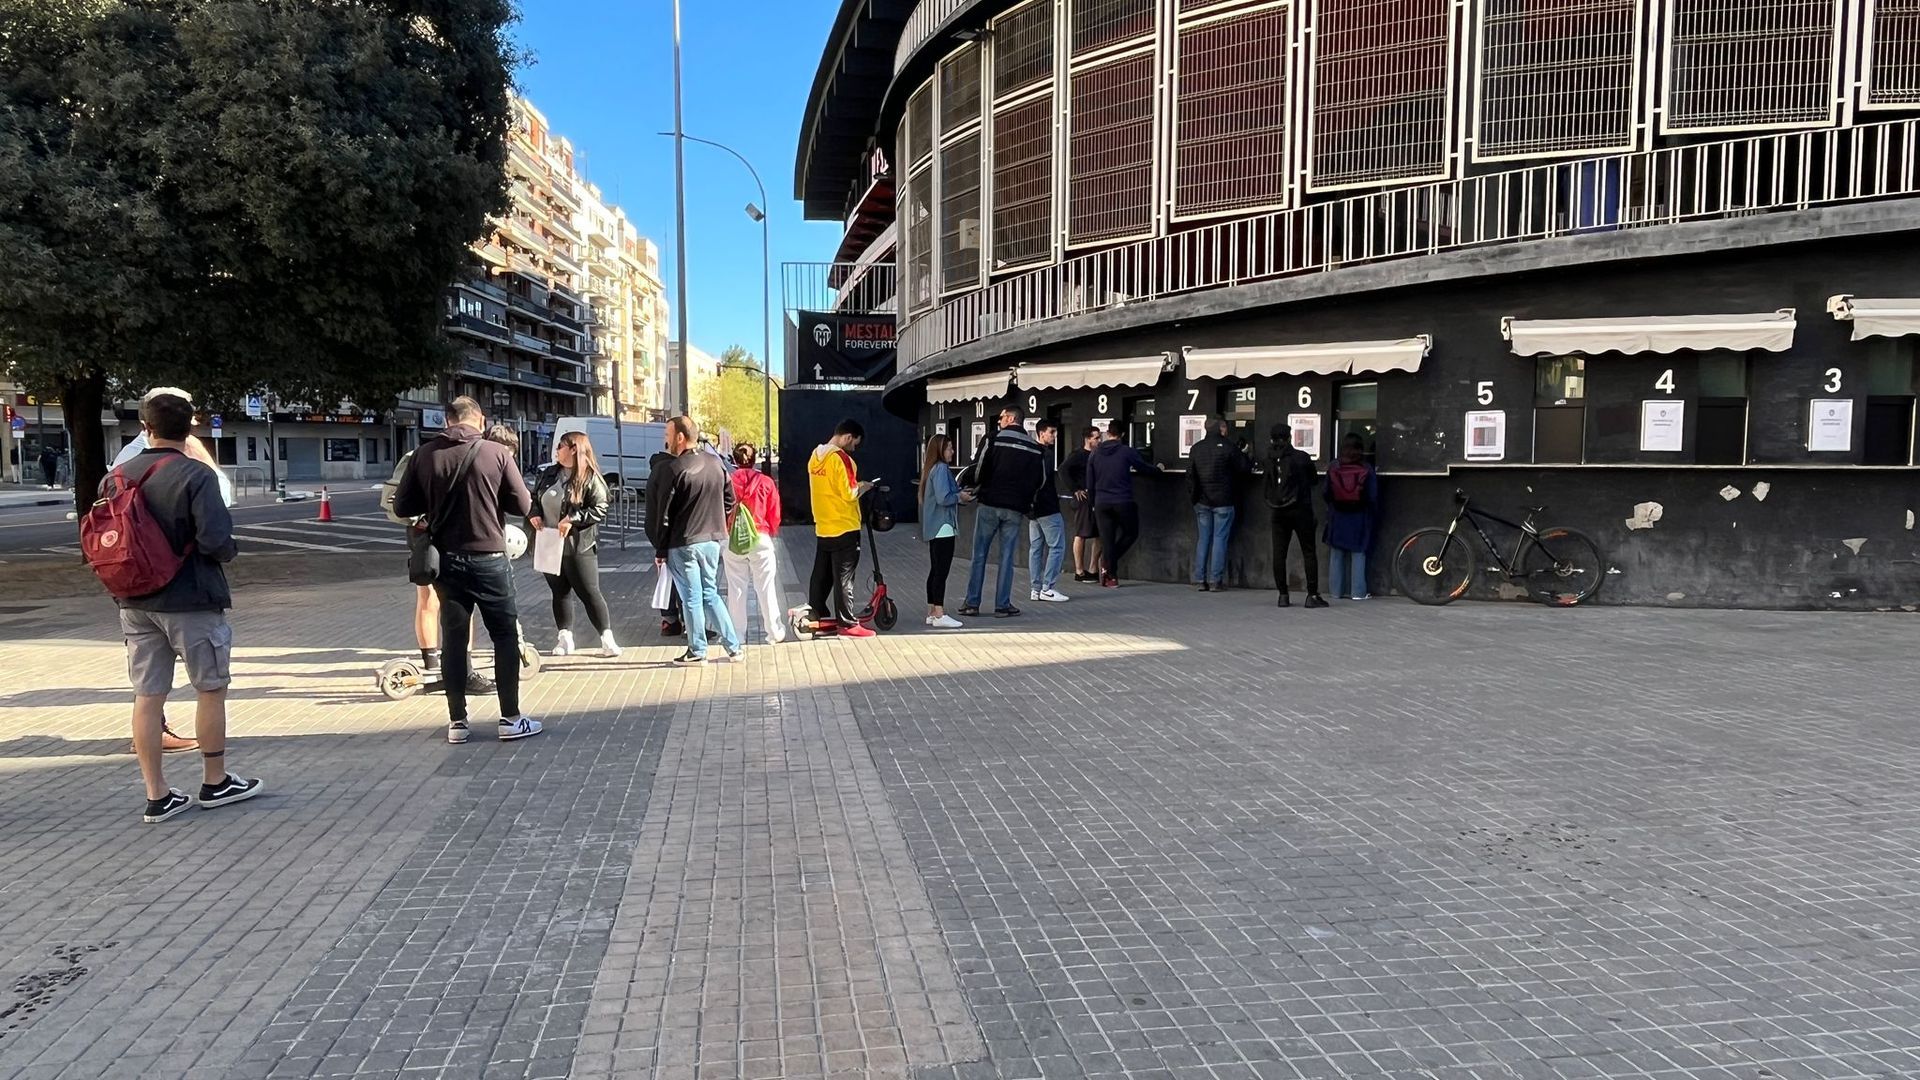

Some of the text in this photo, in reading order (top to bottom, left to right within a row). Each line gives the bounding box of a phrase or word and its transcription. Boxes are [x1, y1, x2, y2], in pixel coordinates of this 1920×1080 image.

[1655, 369, 1675, 394] 4
[1825, 368, 1841, 393] 3
[1188, 389, 1199, 410] 7
[1298, 386, 1311, 408] 6
[1478, 381, 1493, 405] 5
[939, 405, 944, 419] 11
[976, 402, 983, 418] 10
[1029, 396, 1036, 413] 9
[1098, 395, 1107, 413] 8
